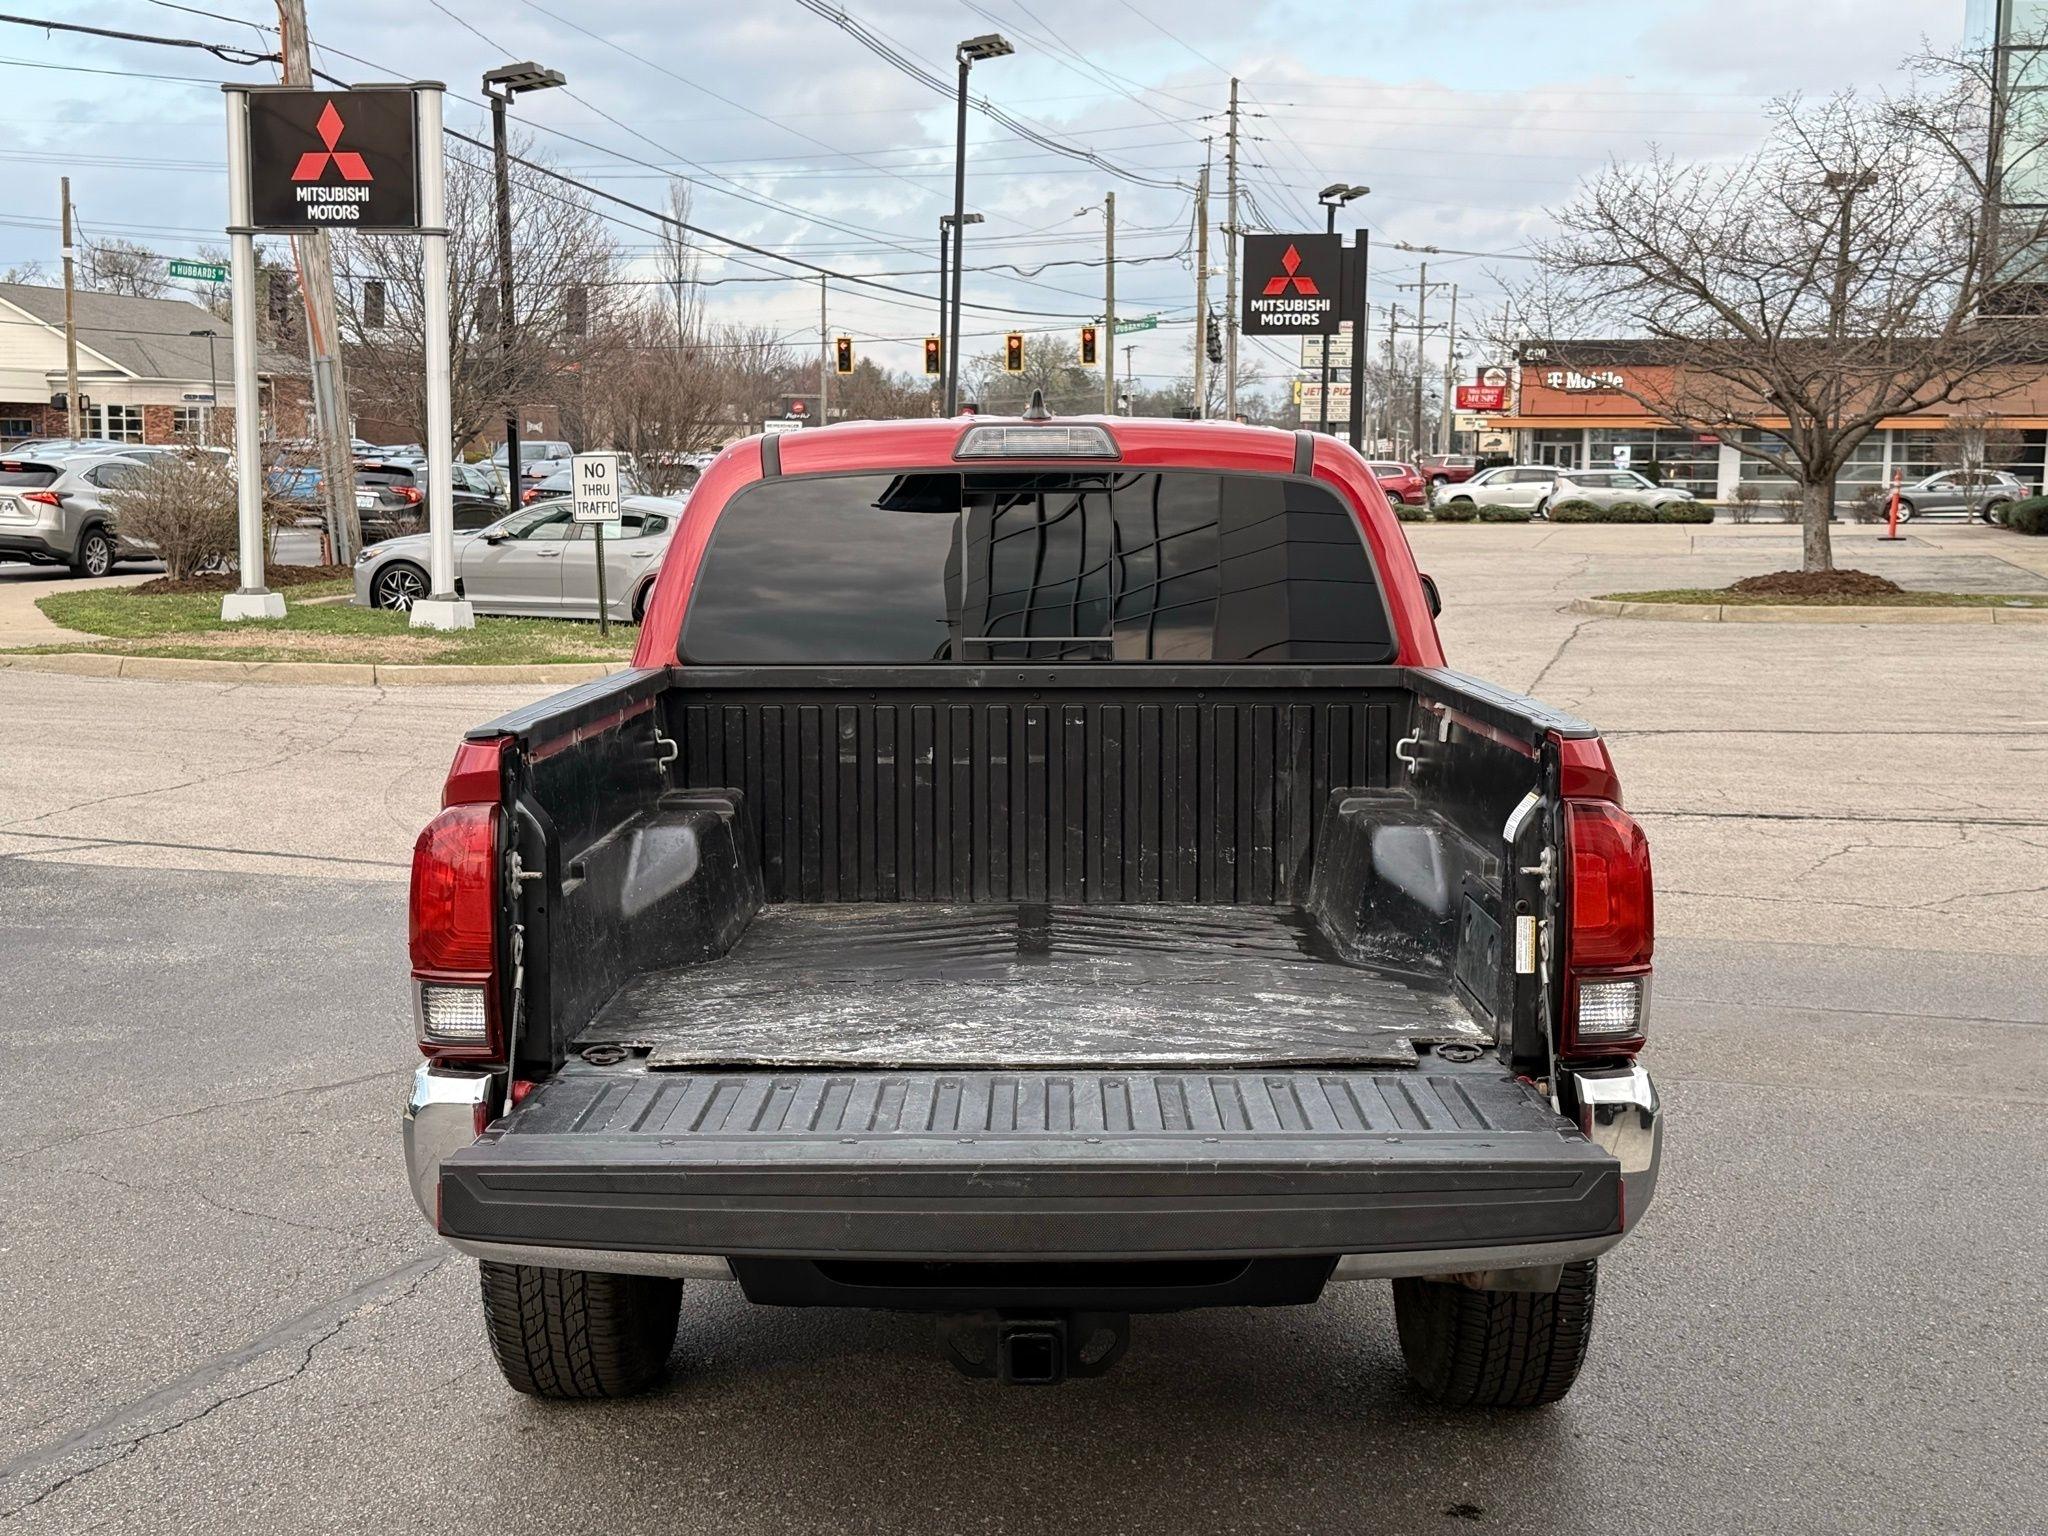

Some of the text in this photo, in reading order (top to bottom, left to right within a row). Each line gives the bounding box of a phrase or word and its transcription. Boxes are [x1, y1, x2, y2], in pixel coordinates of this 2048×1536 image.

[296, 186, 370, 202] MITSUBISHI
[307, 204, 360, 220] MOTORS
[177, 264, 217, 280] HUBBARDS
[1250, 299, 1331, 312] MITSUBISHI
[1260, 313, 1320, 326] MOTORS
[584, 463, 605, 478] NO
[582, 484, 610, 496] THRU
[577, 501, 617, 514] TRAFFIC
